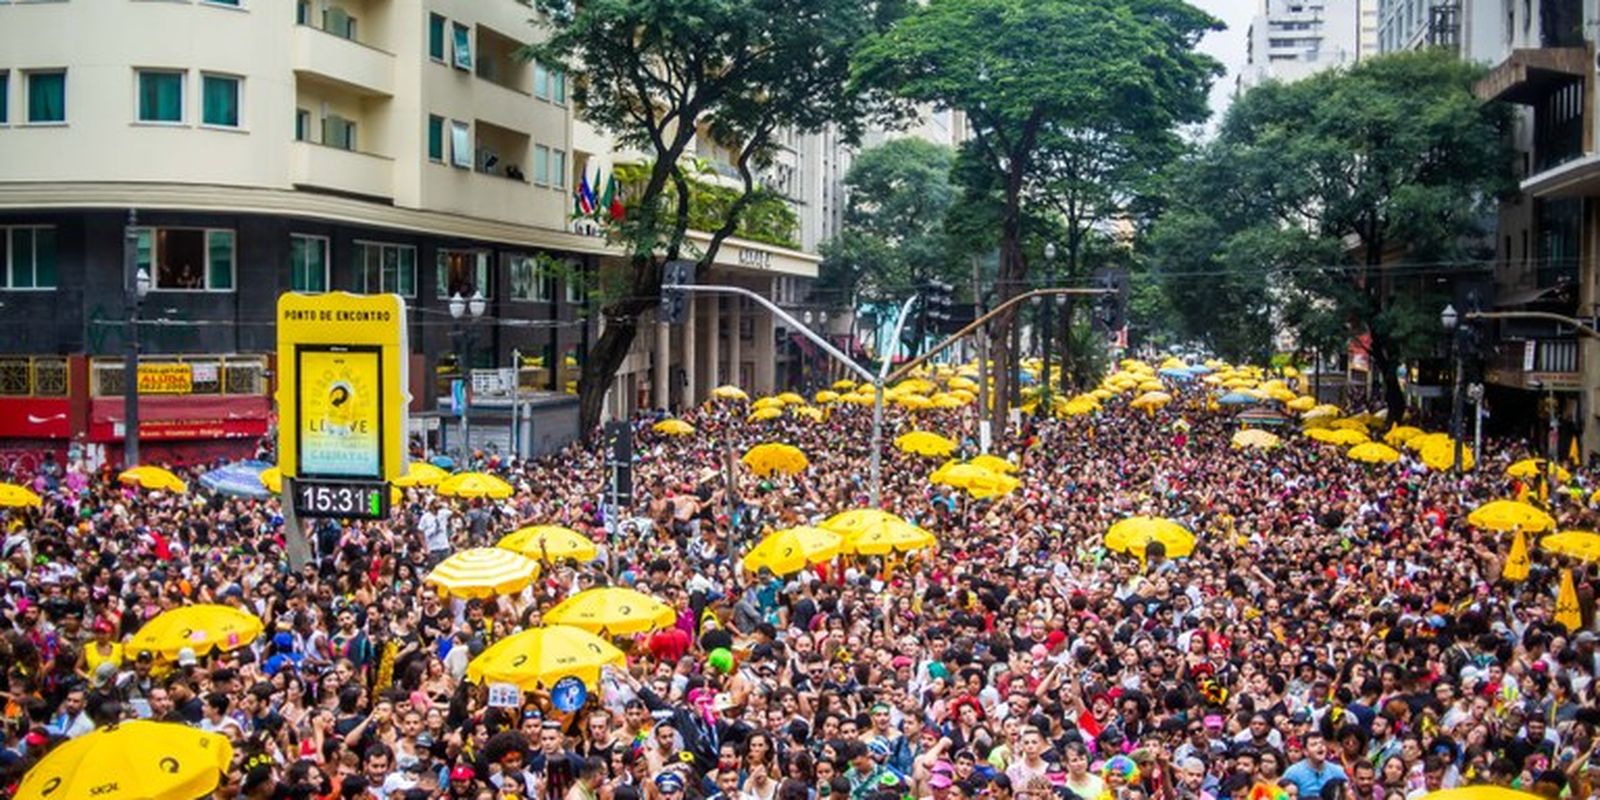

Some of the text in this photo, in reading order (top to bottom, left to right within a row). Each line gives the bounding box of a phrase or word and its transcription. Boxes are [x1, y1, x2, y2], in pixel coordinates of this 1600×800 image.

[284, 310, 391, 322] PONTO DE ENCONTRO
[303, 487, 365, 512] 15:31
